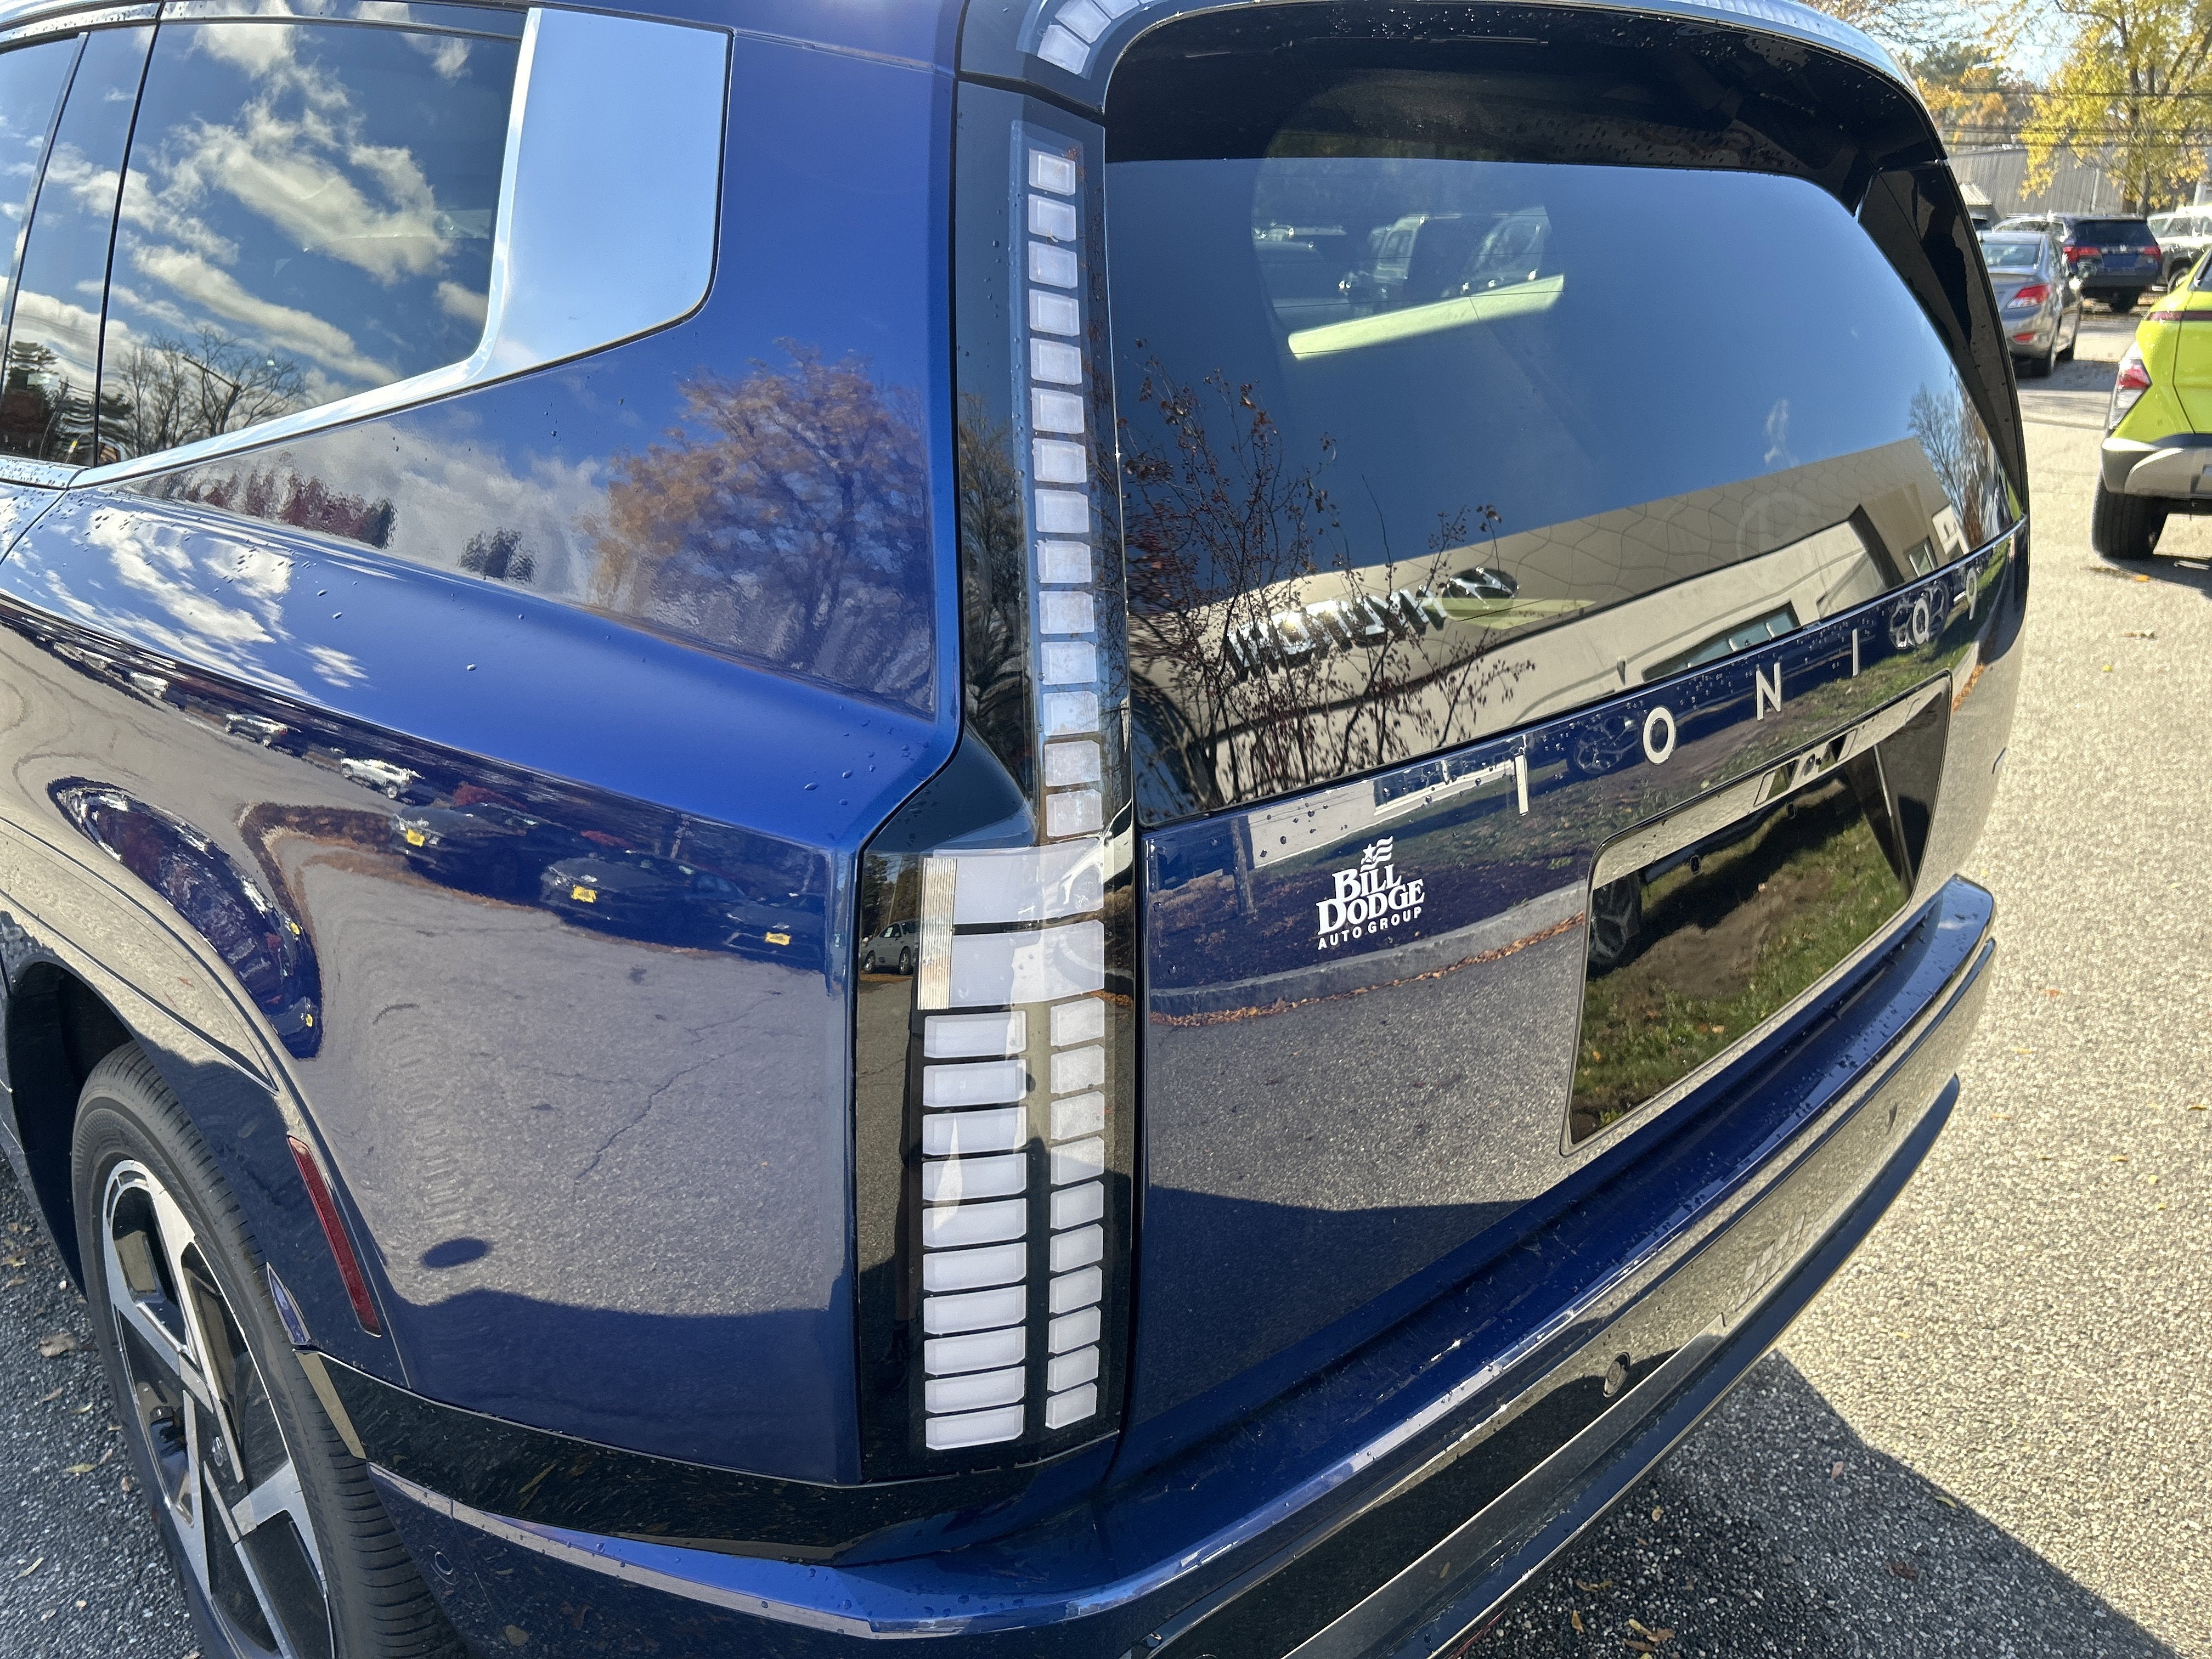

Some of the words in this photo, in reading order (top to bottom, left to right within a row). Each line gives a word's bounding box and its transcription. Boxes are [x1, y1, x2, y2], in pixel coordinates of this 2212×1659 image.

[1966, 567, 1977, 620] 9
[1316, 878, 1425, 935] DODGE
[1332, 864, 1402, 903] BILL
[1318, 926, 1362, 950] AUTO
[1368, 906, 1421, 933] GROUP
